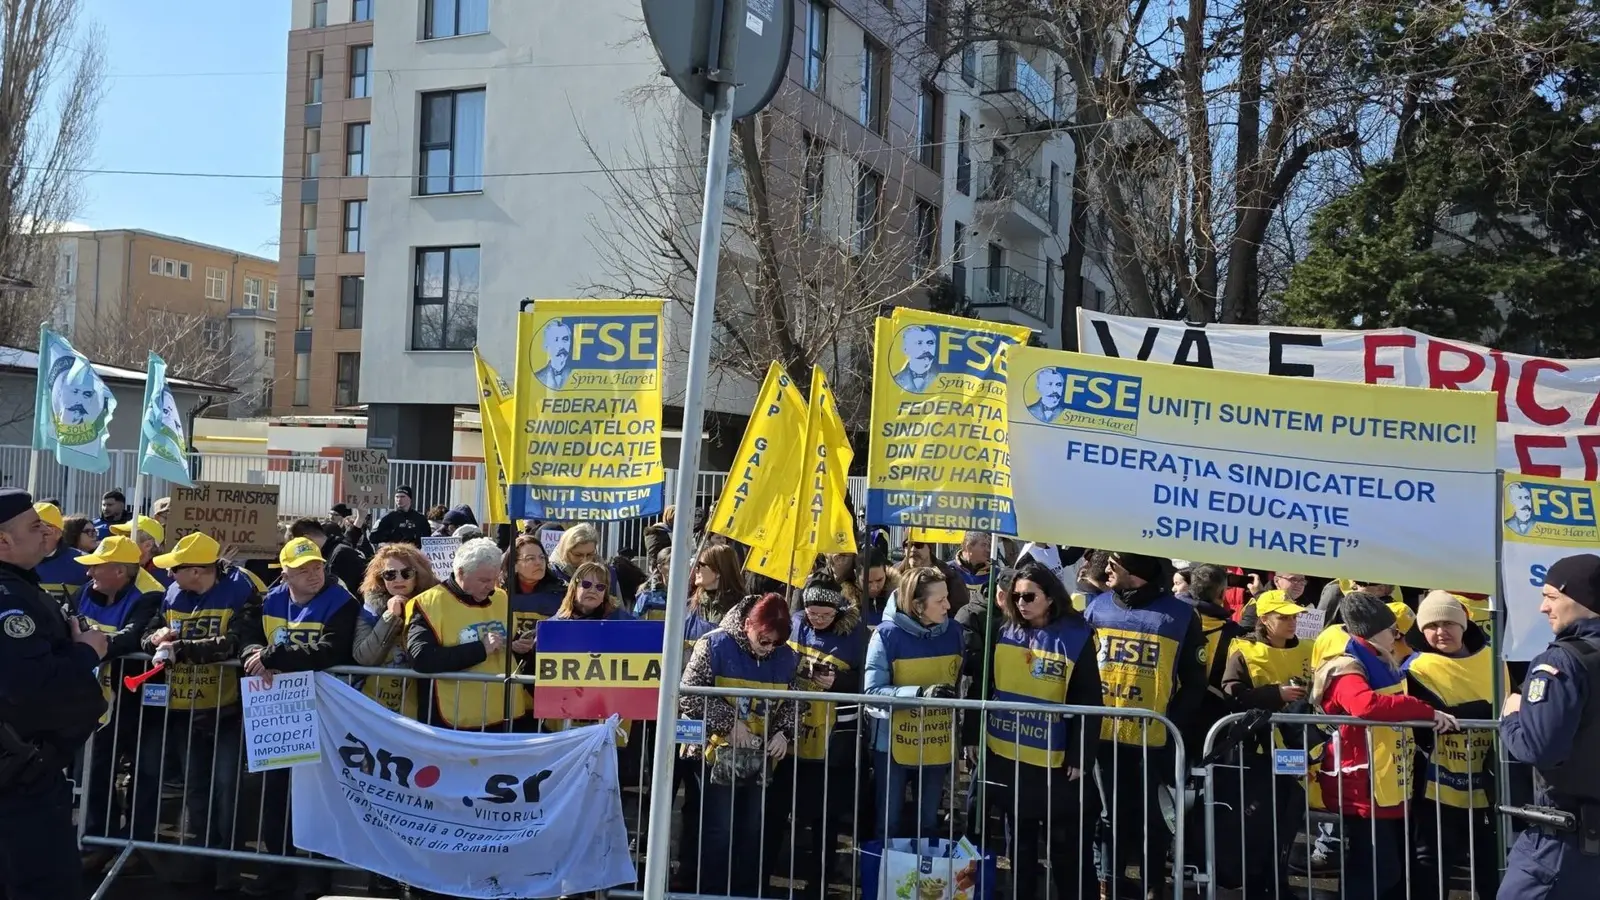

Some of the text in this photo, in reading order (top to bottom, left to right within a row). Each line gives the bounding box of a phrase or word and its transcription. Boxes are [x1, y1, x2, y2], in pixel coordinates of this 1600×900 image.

[571, 322, 655, 362] FSE
[1091, 318, 1214, 369] VĂ
[570, 371, 654, 389] Spiru Haret
[937, 376, 1005, 396] Spiru Har
[768, 375, 790, 417] SIP
[1064, 374, 1140, 413] FSE
[541, 397, 637, 418] FEDERAȚIA
[898, 400, 1003, 423] FEDERAȚIA
[524, 419, 655, 435] SINDICATELOR
[1063, 410, 1135, 432] Spiru Haret
[1148, 395, 1476, 444] UNIȚI SUNTEM PUTERNICI!
[345, 449, 388, 465] BURSA
[528, 440, 656, 462] DIN EDUCAȚIE
[885, 444, 916, 459] DIN
[878, 465, 945, 483] „SPIRU
[1066, 440, 1436, 503] FEDERAȚIA SINDICATELOR
[216, 490, 279, 506] TRANSPORT
[530, 487, 651, 506] UNIȚI SUNTEM
[887, 493, 1011, 513] UNIȚI SUNTEM
[1530, 487, 1594, 521] FSE
[545, 504, 640, 520] PUTERNICI!
[1153, 483, 1349, 530] DIN EDUCAȚIE
[900, 512, 1001, 530] PUTERNICI!
[1141, 515, 1239, 546] „SPIRU
[175, 524, 200, 541] ST
[232, 530, 255, 544] LOC
[1535, 524, 1597, 538] Spiru Haret
[182, 618, 221, 639] FSE
[1109, 638, 1158, 666] FSE
[539, 653, 662, 681] BRĂILA
[248, 674, 309, 693] NU mai
[250, 687, 309, 706] penalizați
[250, 700, 311, 717] MERITUL
[251, 712, 313, 731] pentru a
[676, 725, 702, 734] DGJMB
[253, 725, 313, 744] acoperi
[254, 741, 316, 757] IMPOSTURA!
[1277, 755, 1305, 763] DGJMB
[440, 827, 449, 836] a
[427, 839, 449, 850] din
